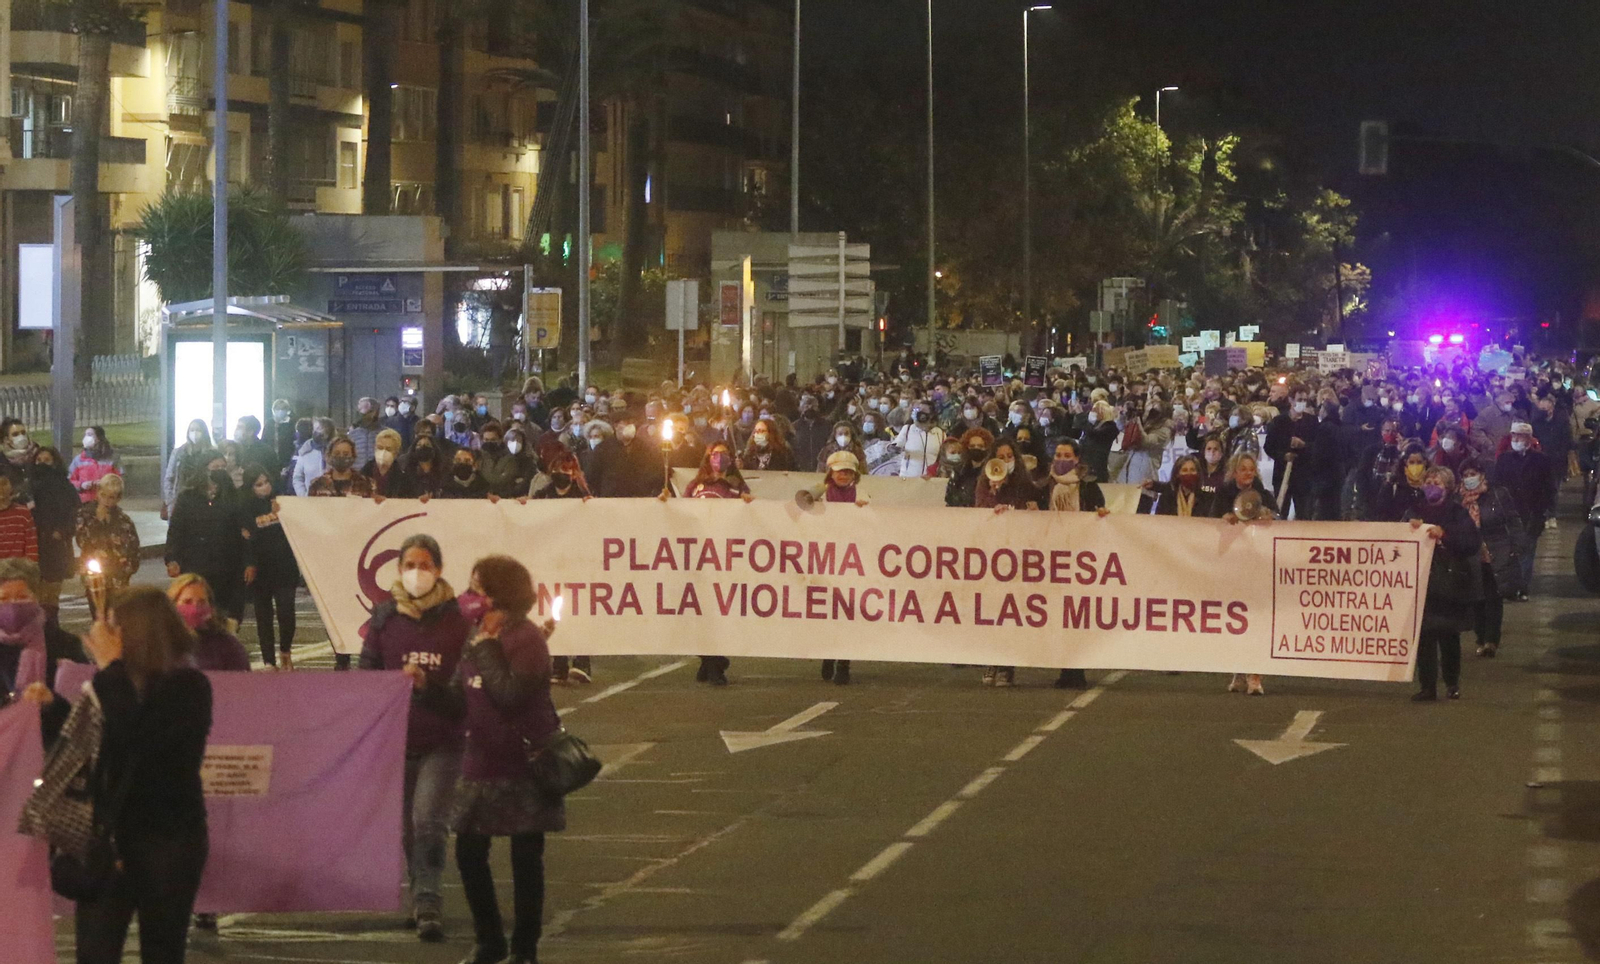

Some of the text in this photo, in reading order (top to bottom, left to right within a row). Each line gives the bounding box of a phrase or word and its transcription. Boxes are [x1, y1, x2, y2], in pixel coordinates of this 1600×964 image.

[338, 276, 348, 288] P
[346, 303, 386, 311] ENTRADA
[536, 328, 547, 344] P
[603, 537, 1127, 586] PLATAFORMA CORDOBESA
[1309, 544, 1386, 565] 25N DÍA
[1279, 568, 1413, 588] INTERNACIONAL
[537, 582, 1249, 635] NTRA LA VIOLENCIA A LAS MUJERES
[1300, 590, 1393, 610] CONTRA LA
[1301, 612, 1390, 633] VIOLENCIA
[1278, 634, 1409, 656] A LAS MUJERES
